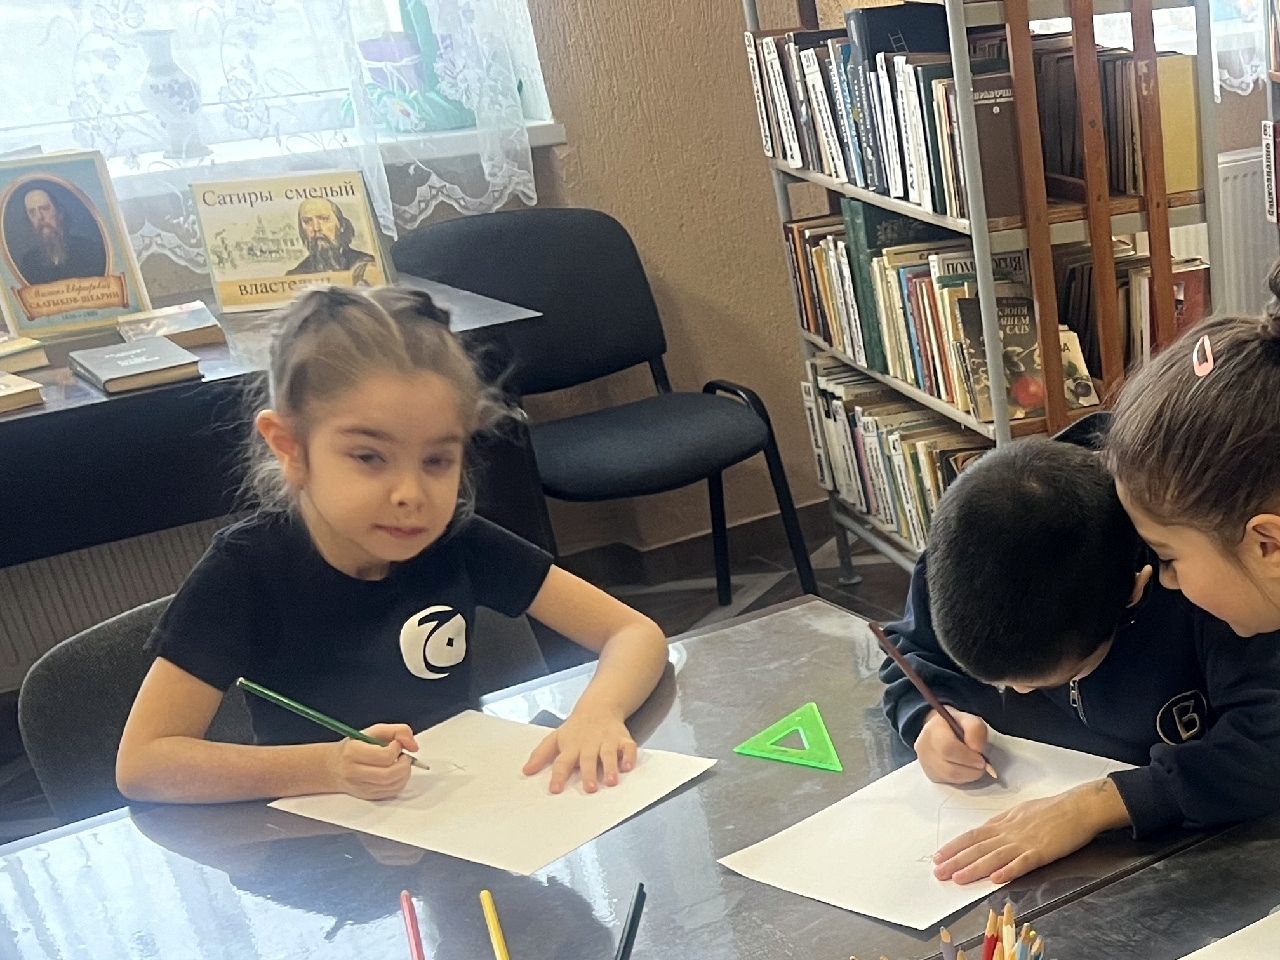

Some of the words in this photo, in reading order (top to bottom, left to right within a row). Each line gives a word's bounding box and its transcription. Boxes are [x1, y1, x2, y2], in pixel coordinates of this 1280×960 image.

[202, 189, 273, 208] Сатиры
[284, 180, 356, 201] смелый
[945, 255, 1023, 275] ПОМОГИЯ
